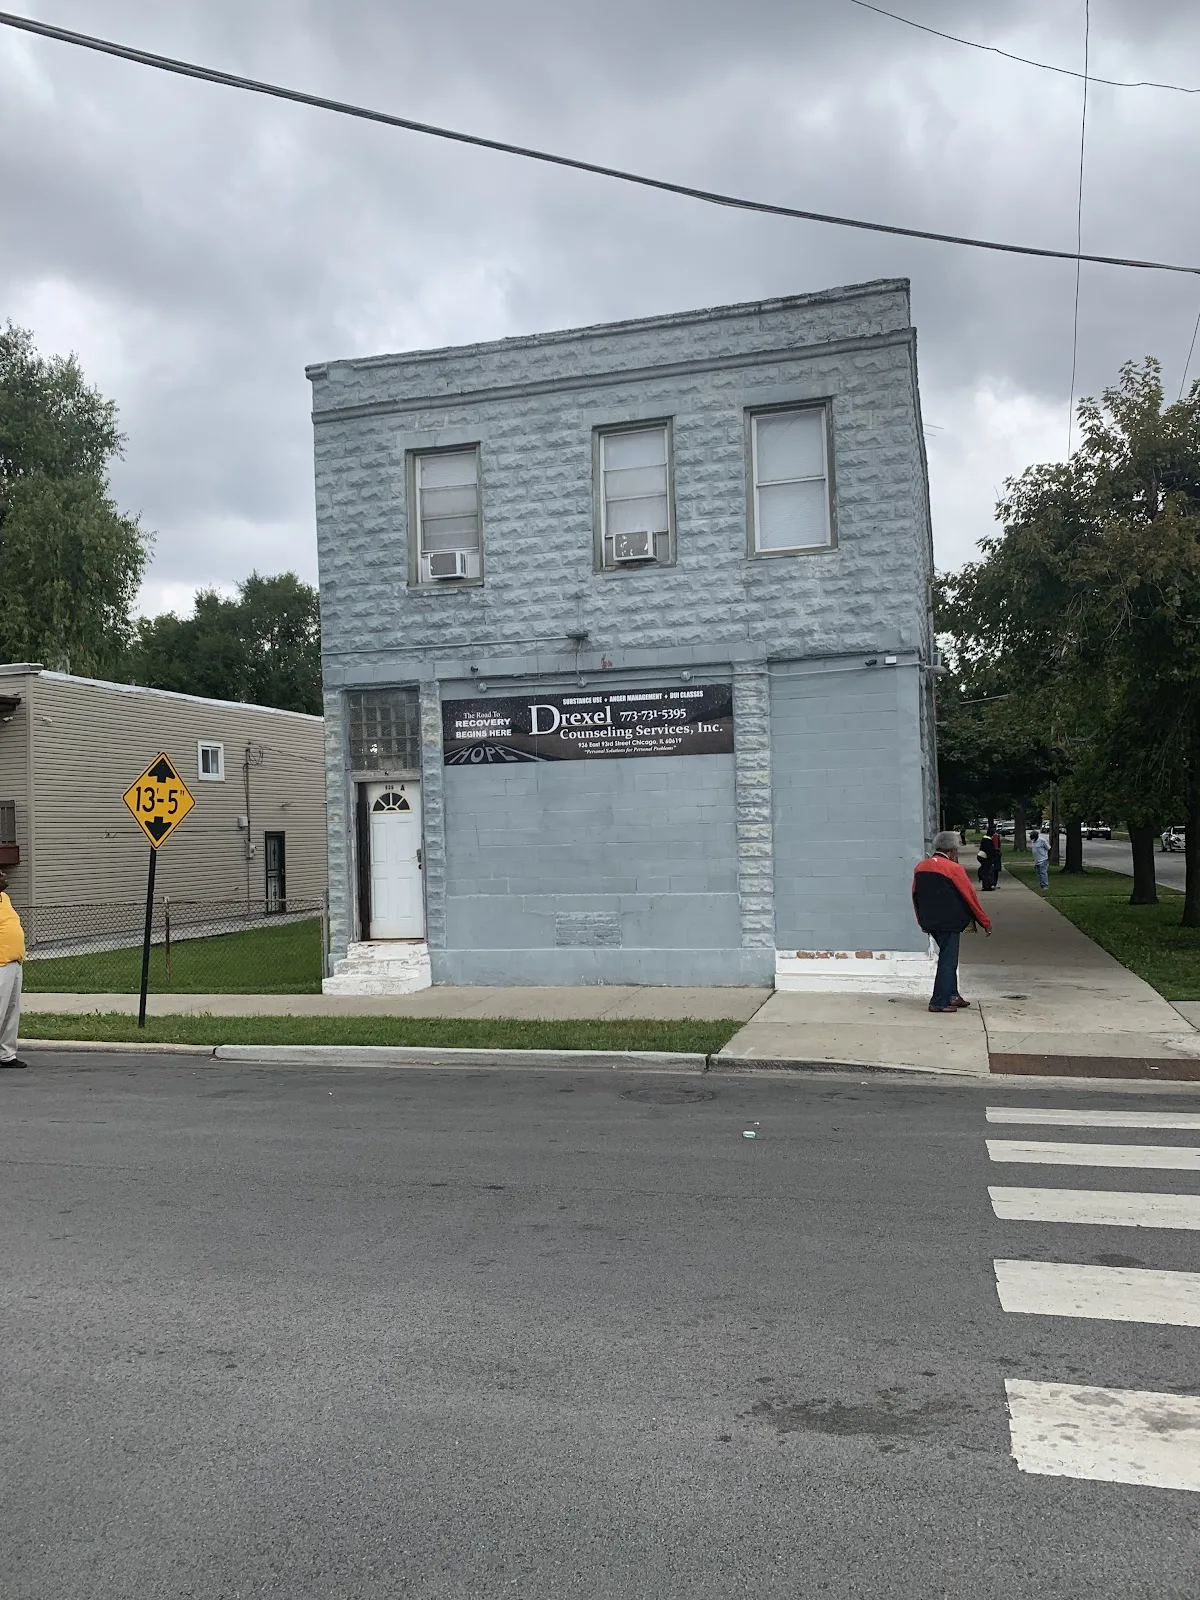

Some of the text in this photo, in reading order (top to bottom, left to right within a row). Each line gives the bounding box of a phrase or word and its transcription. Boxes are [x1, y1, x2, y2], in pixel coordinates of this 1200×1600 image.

[562, 697, 592, 705] SUBSTANCE
[592, 696, 602, 704] USE
[627, 693, 662, 702] MANAGEMENT
[680, 690, 704, 698] CLASSES
[476, 711, 492, 719] Road
[528, 704, 687, 735] Drexel 773-731-5395
[455, 718, 511, 728] RECOVERY
[455, 729, 512, 738] BEGINS HERE
[560, 721, 724, 740] Counseling Services, Inc.
[614, 739, 631, 747] Street
[448, 746, 519, 764] HOPE
